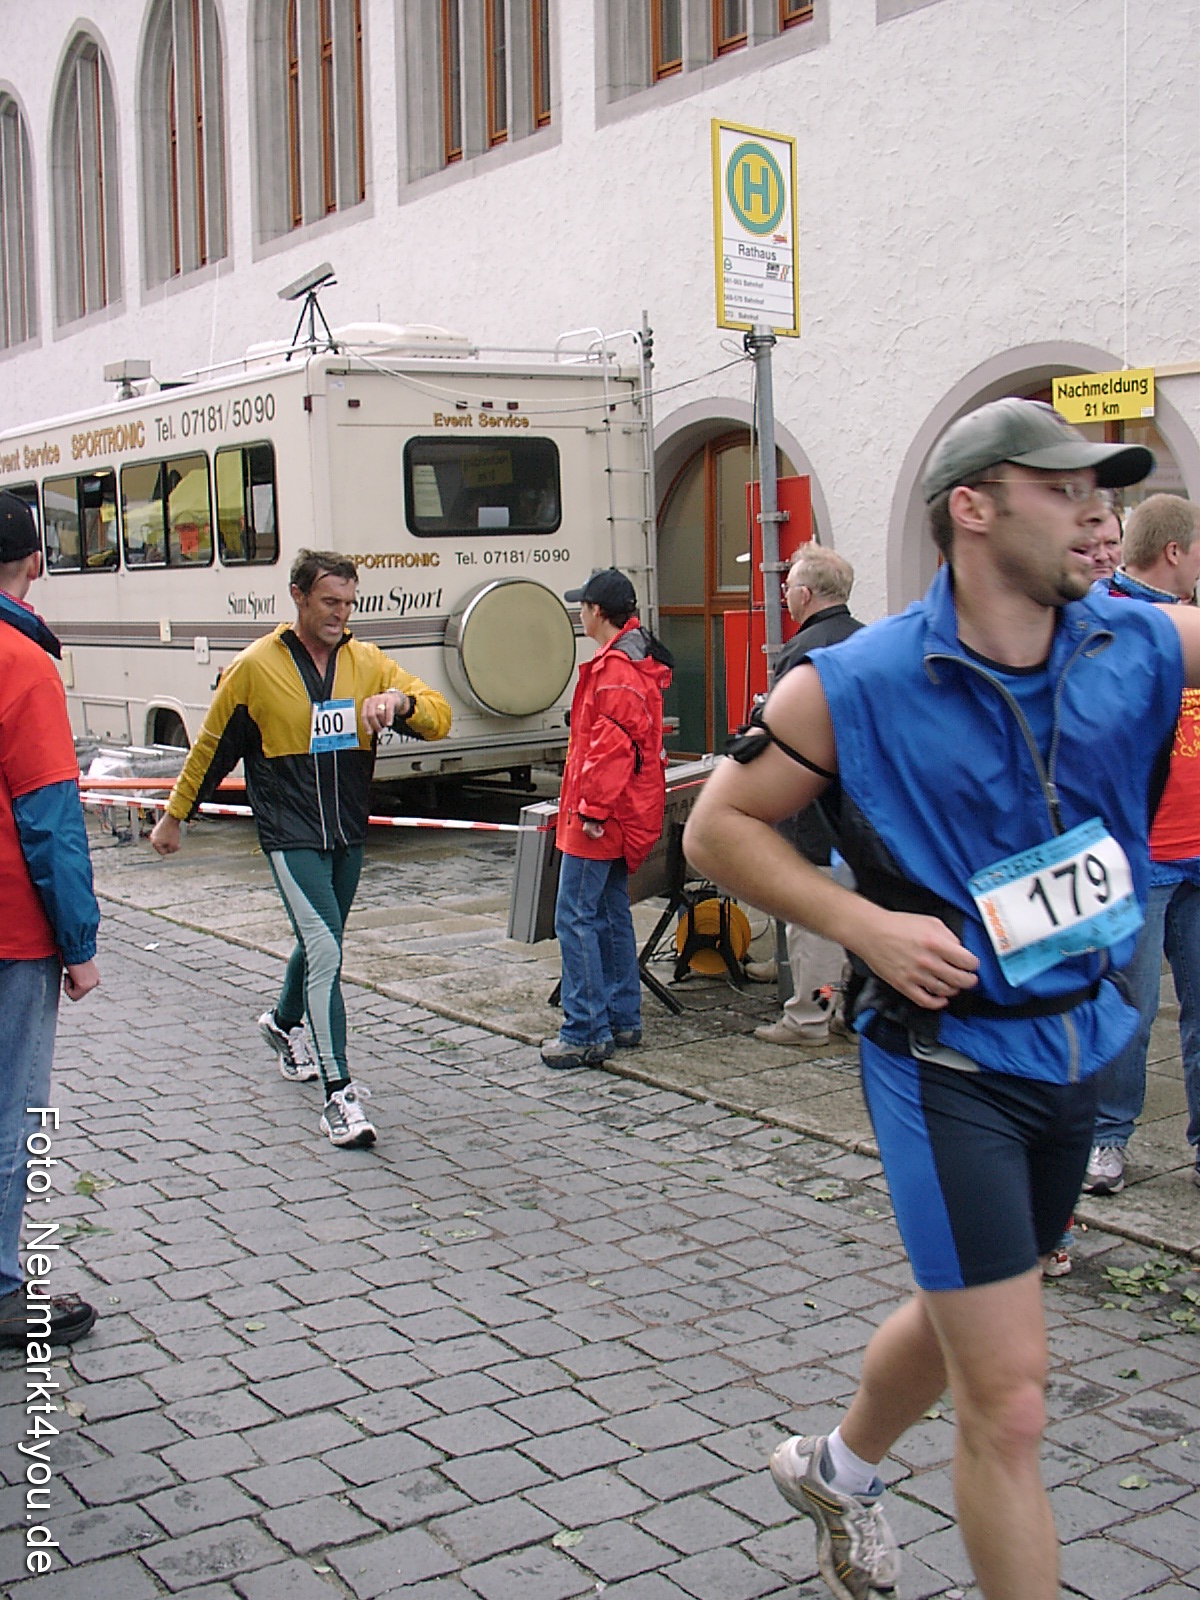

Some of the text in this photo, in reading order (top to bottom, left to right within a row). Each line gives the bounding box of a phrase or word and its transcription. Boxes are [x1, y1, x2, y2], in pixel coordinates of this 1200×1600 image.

[738, 243, 777, 262] Rathaus
[1057, 378, 1148, 399] Nachmeldung
[1085, 402, 1120, 416] 21 km
[433, 412, 530, 428] Event Service
[0, 393, 275, 474] vent Service SPORTRONIC Tel. 07181/5090
[455, 551, 478, 565] Tel.
[483, 548, 570, 564] 07181/5090
[387, 586, 443, 616] Sport
[1027, 853, 1111, 926] 179
